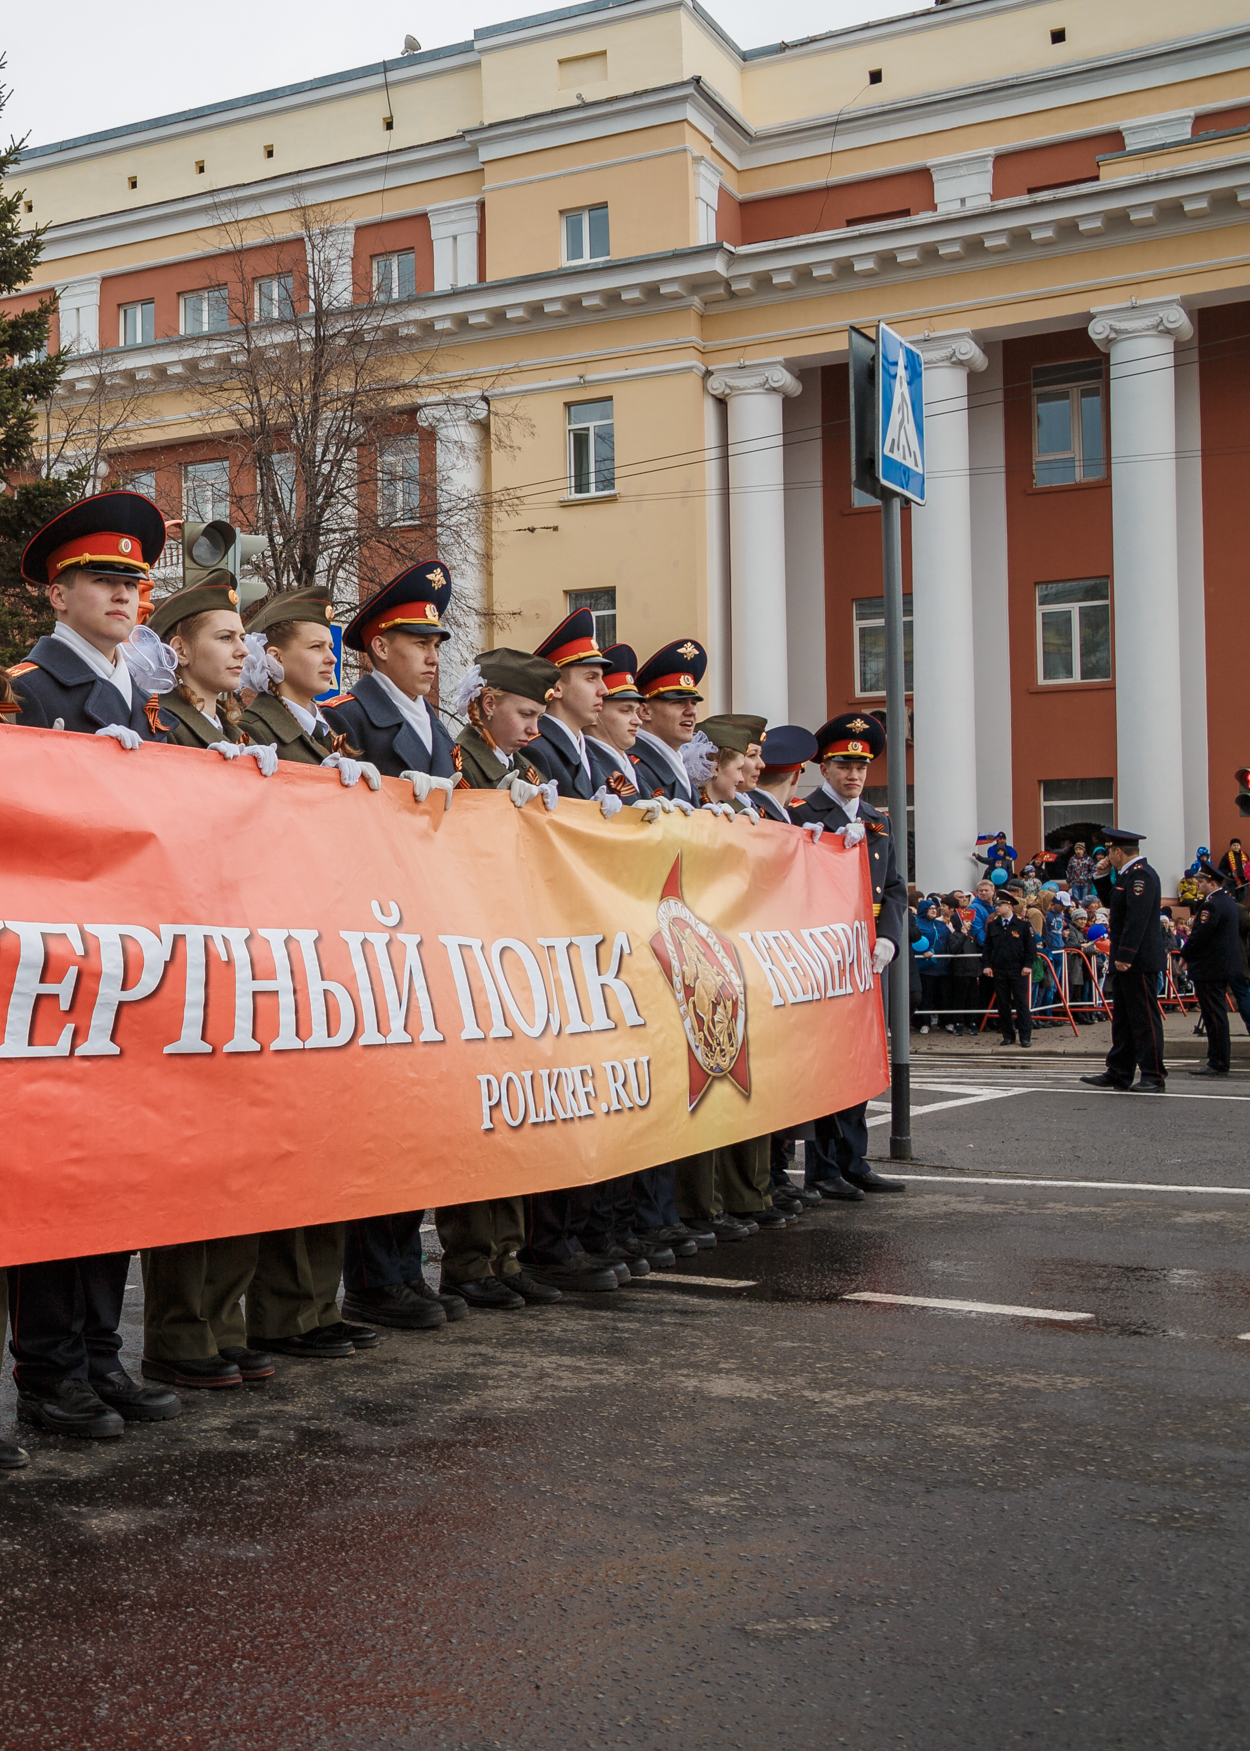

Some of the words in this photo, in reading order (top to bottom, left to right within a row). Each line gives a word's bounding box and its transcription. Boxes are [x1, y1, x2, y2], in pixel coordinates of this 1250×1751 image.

[438, 931, 646, 1039] ПОЛК
[706, 929, 745, 1012] РОССИИ
[477, 1055, 650, 1130] POLKRF.RU
